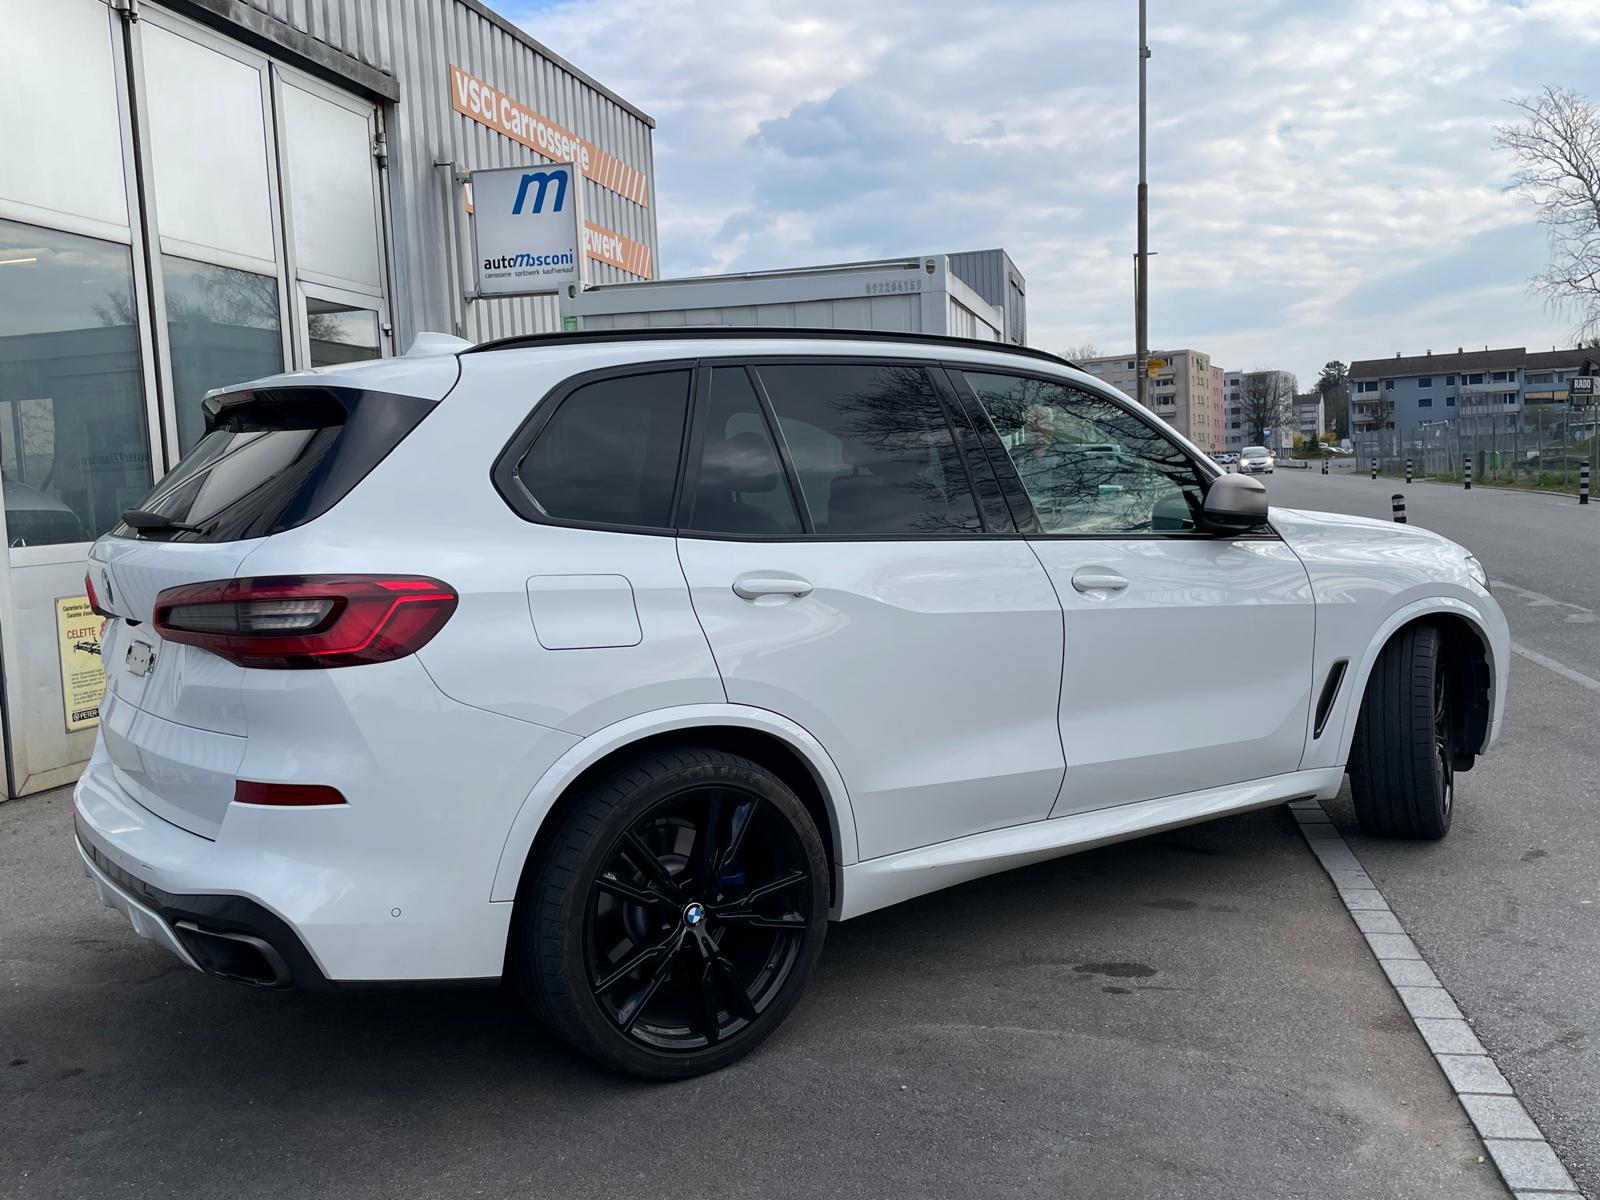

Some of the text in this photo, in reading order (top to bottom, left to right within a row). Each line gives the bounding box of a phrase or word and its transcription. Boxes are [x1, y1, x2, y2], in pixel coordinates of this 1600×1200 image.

[455, 71, 590, 172] VSCI Carrosserie
[584, 228, 624, 264] zwerk
[484, 271, 512, 279] carrosserie
[514, 269, 540, 278] spritzwerk
[67, 627, 96, 640] CELETTE
